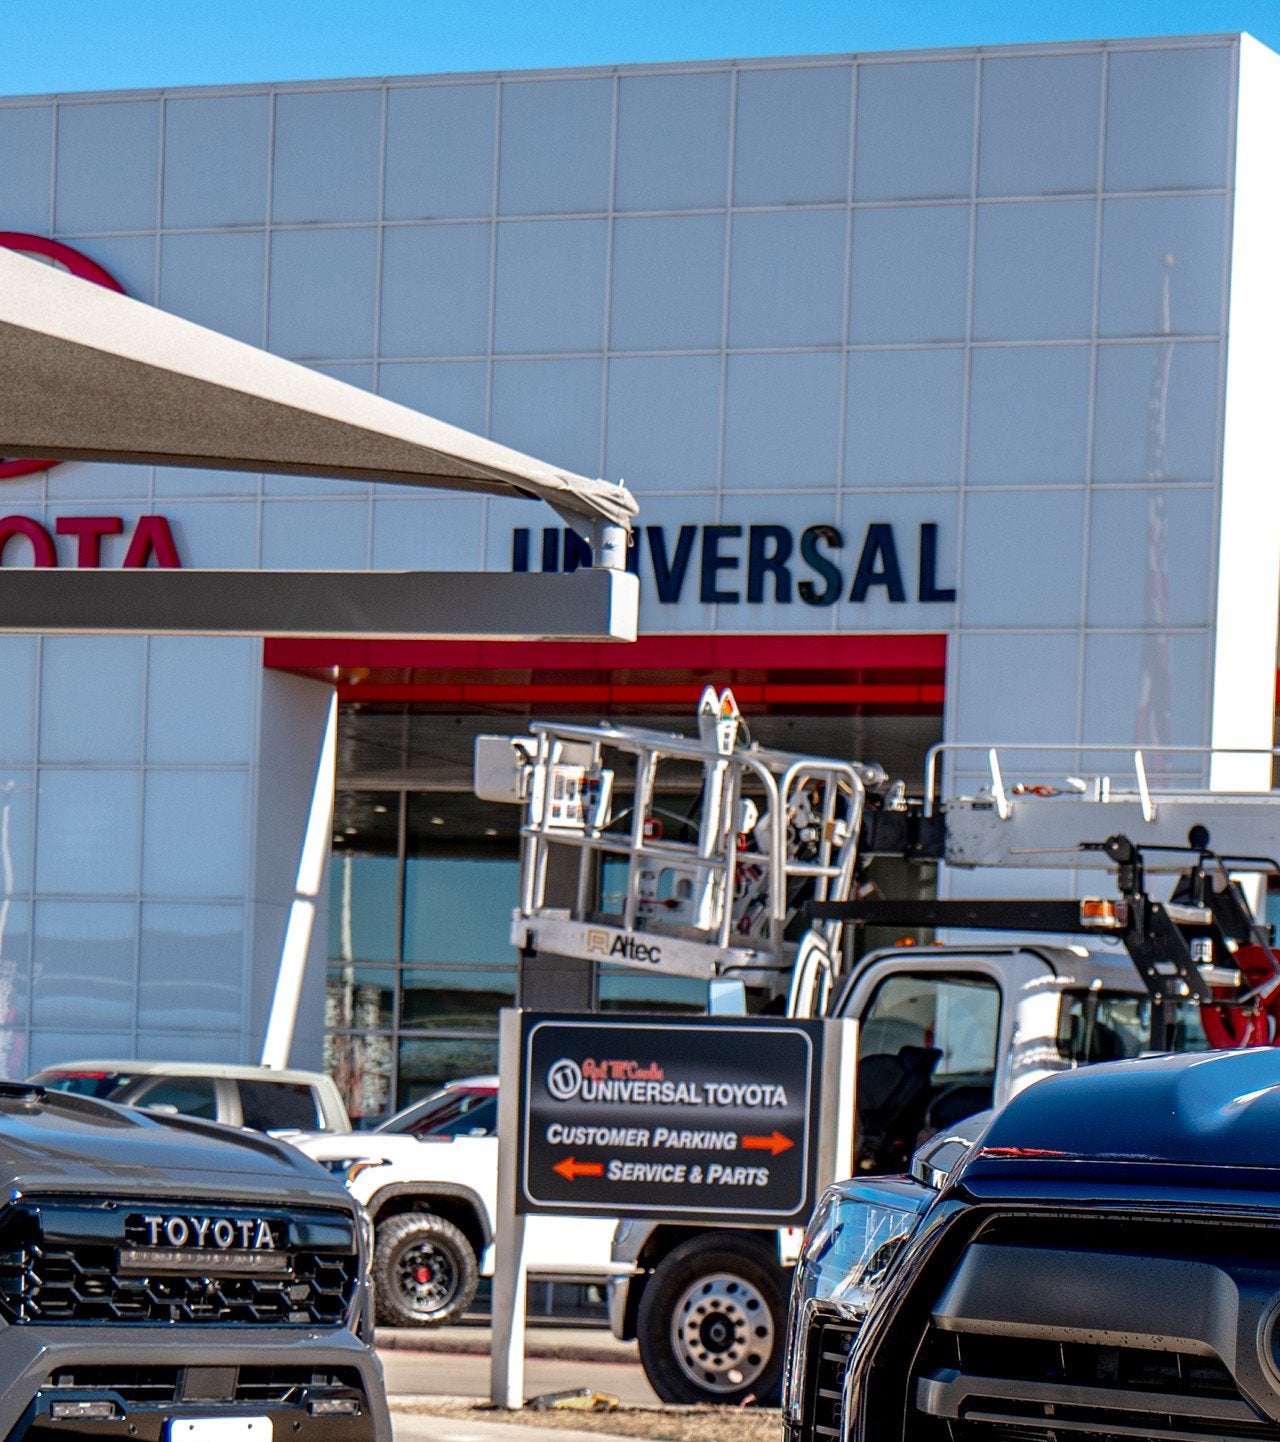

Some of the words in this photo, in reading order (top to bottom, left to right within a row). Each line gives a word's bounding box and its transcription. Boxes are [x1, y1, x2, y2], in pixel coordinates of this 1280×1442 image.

[610, 934, 661, 964] Altec
[582, 1079, 702, 1103] UNIVERSAL
[704, 1083, 788, 1107] TOYOTA
[546, 1122, 651, 1148] CUSTOMER
[653, 1127, 738, 1151] PARKING
[607, 1159, 687, 1184] SERVICE
[689, 1166, 703, 1184] &
[706, 1163, 770, 1188] PARTS
[145, 1215, 276, 1250] TOYOTA
